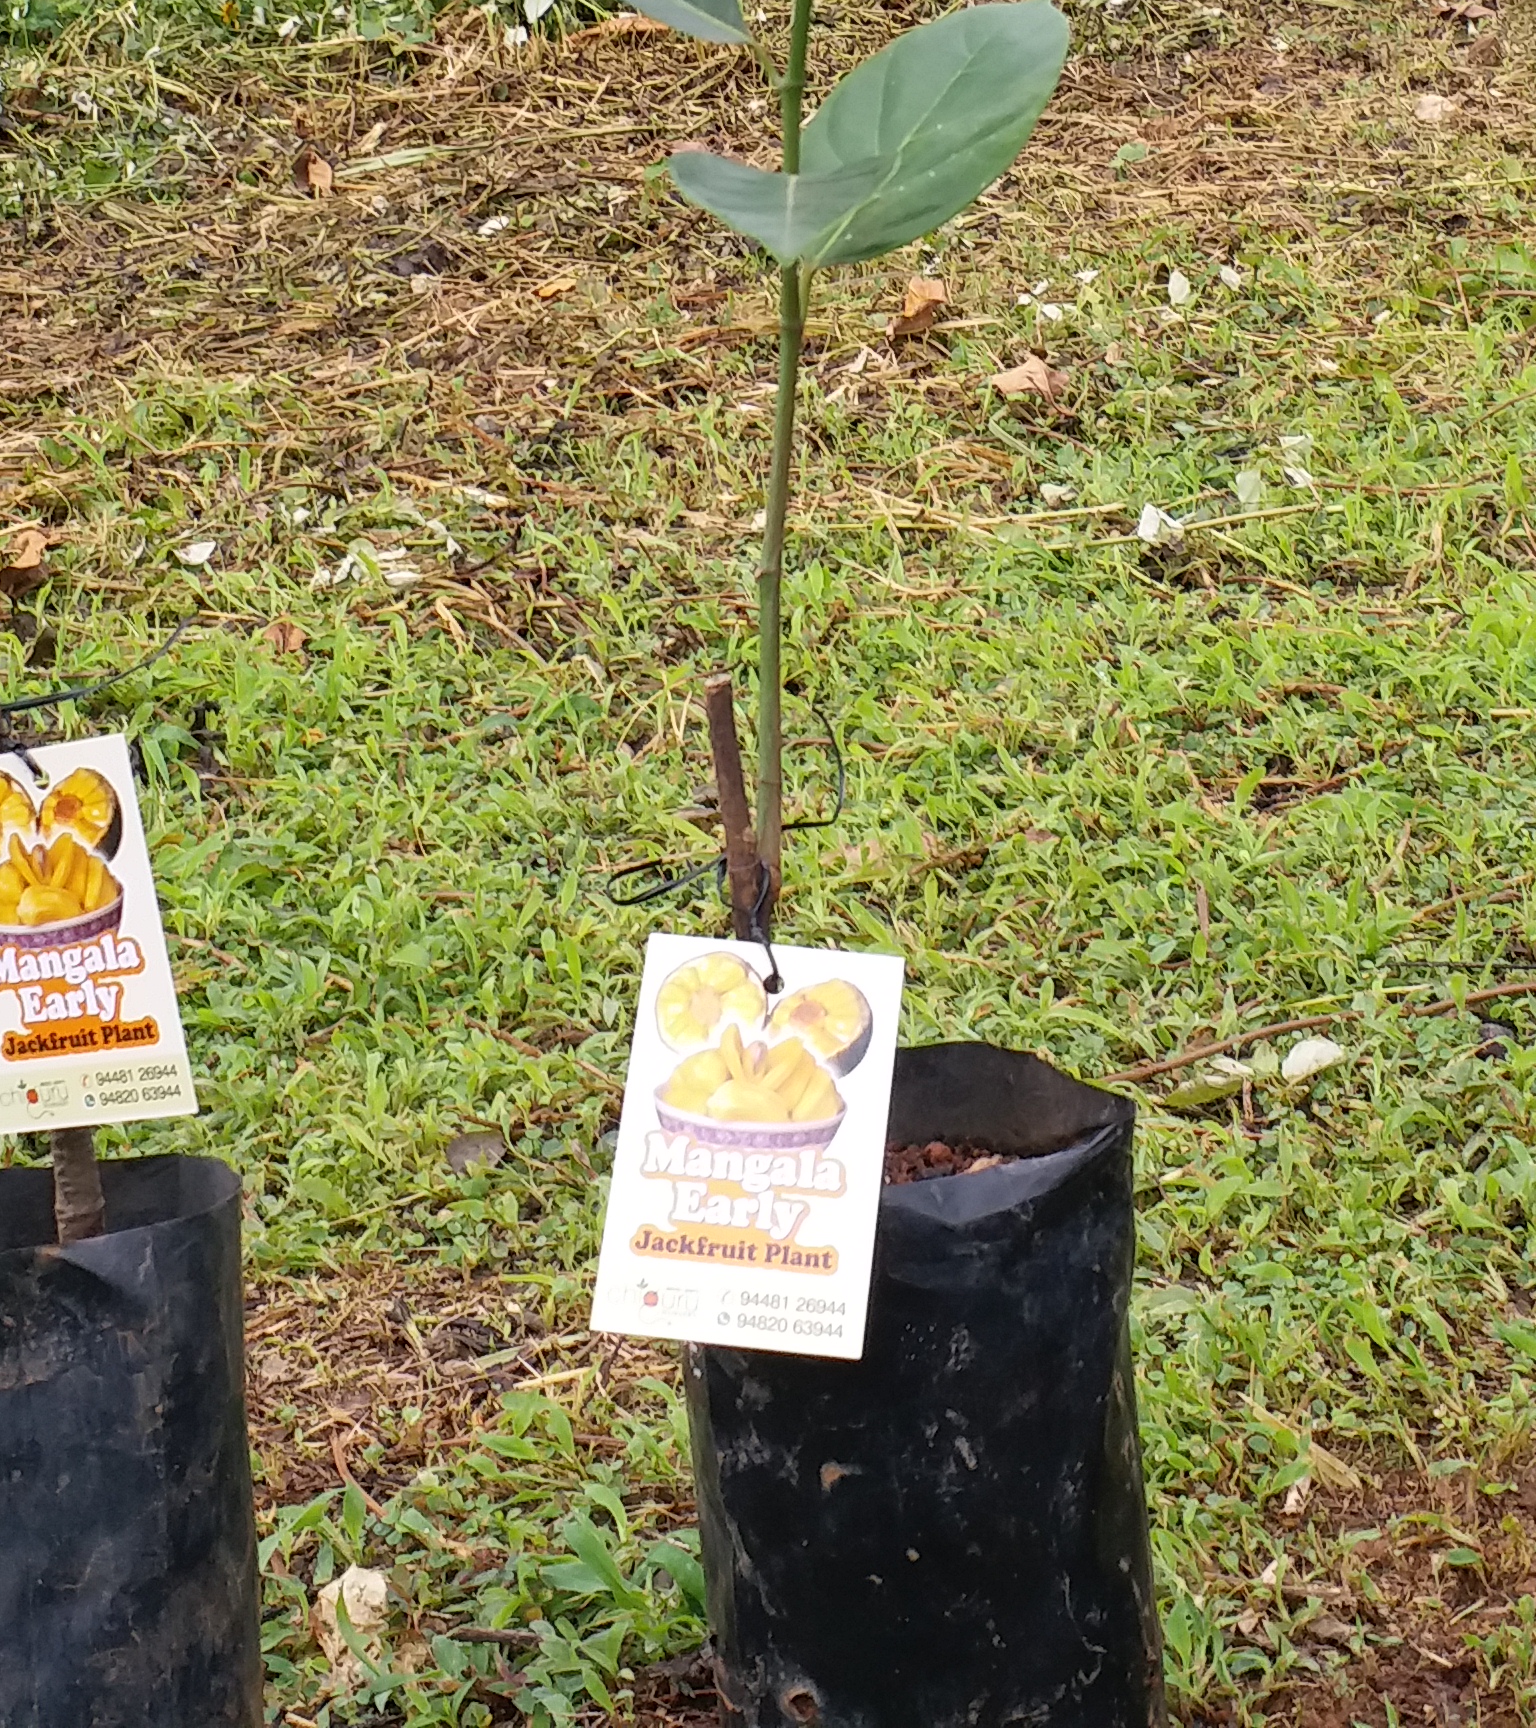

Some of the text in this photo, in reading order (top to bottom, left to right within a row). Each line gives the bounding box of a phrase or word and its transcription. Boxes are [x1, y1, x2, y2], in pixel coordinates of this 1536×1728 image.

[17, 978, 119, 1024] Early
[4, 1022, 156, 1056] Jackfruit Plant
[95, 1064, 178, 1087] 94481 26944
[99, 1084, 182, 1107] 94820 63944
[642, 1132, 843, 1194] Mangala
[671, 1182, 806, 1241] Early
[634, 1230, 833, 1270] Jackfruit Plant
[740, 1291, 846, 1316] 94481 26944
[736, 1313, 844, 1339] 94820 63944
